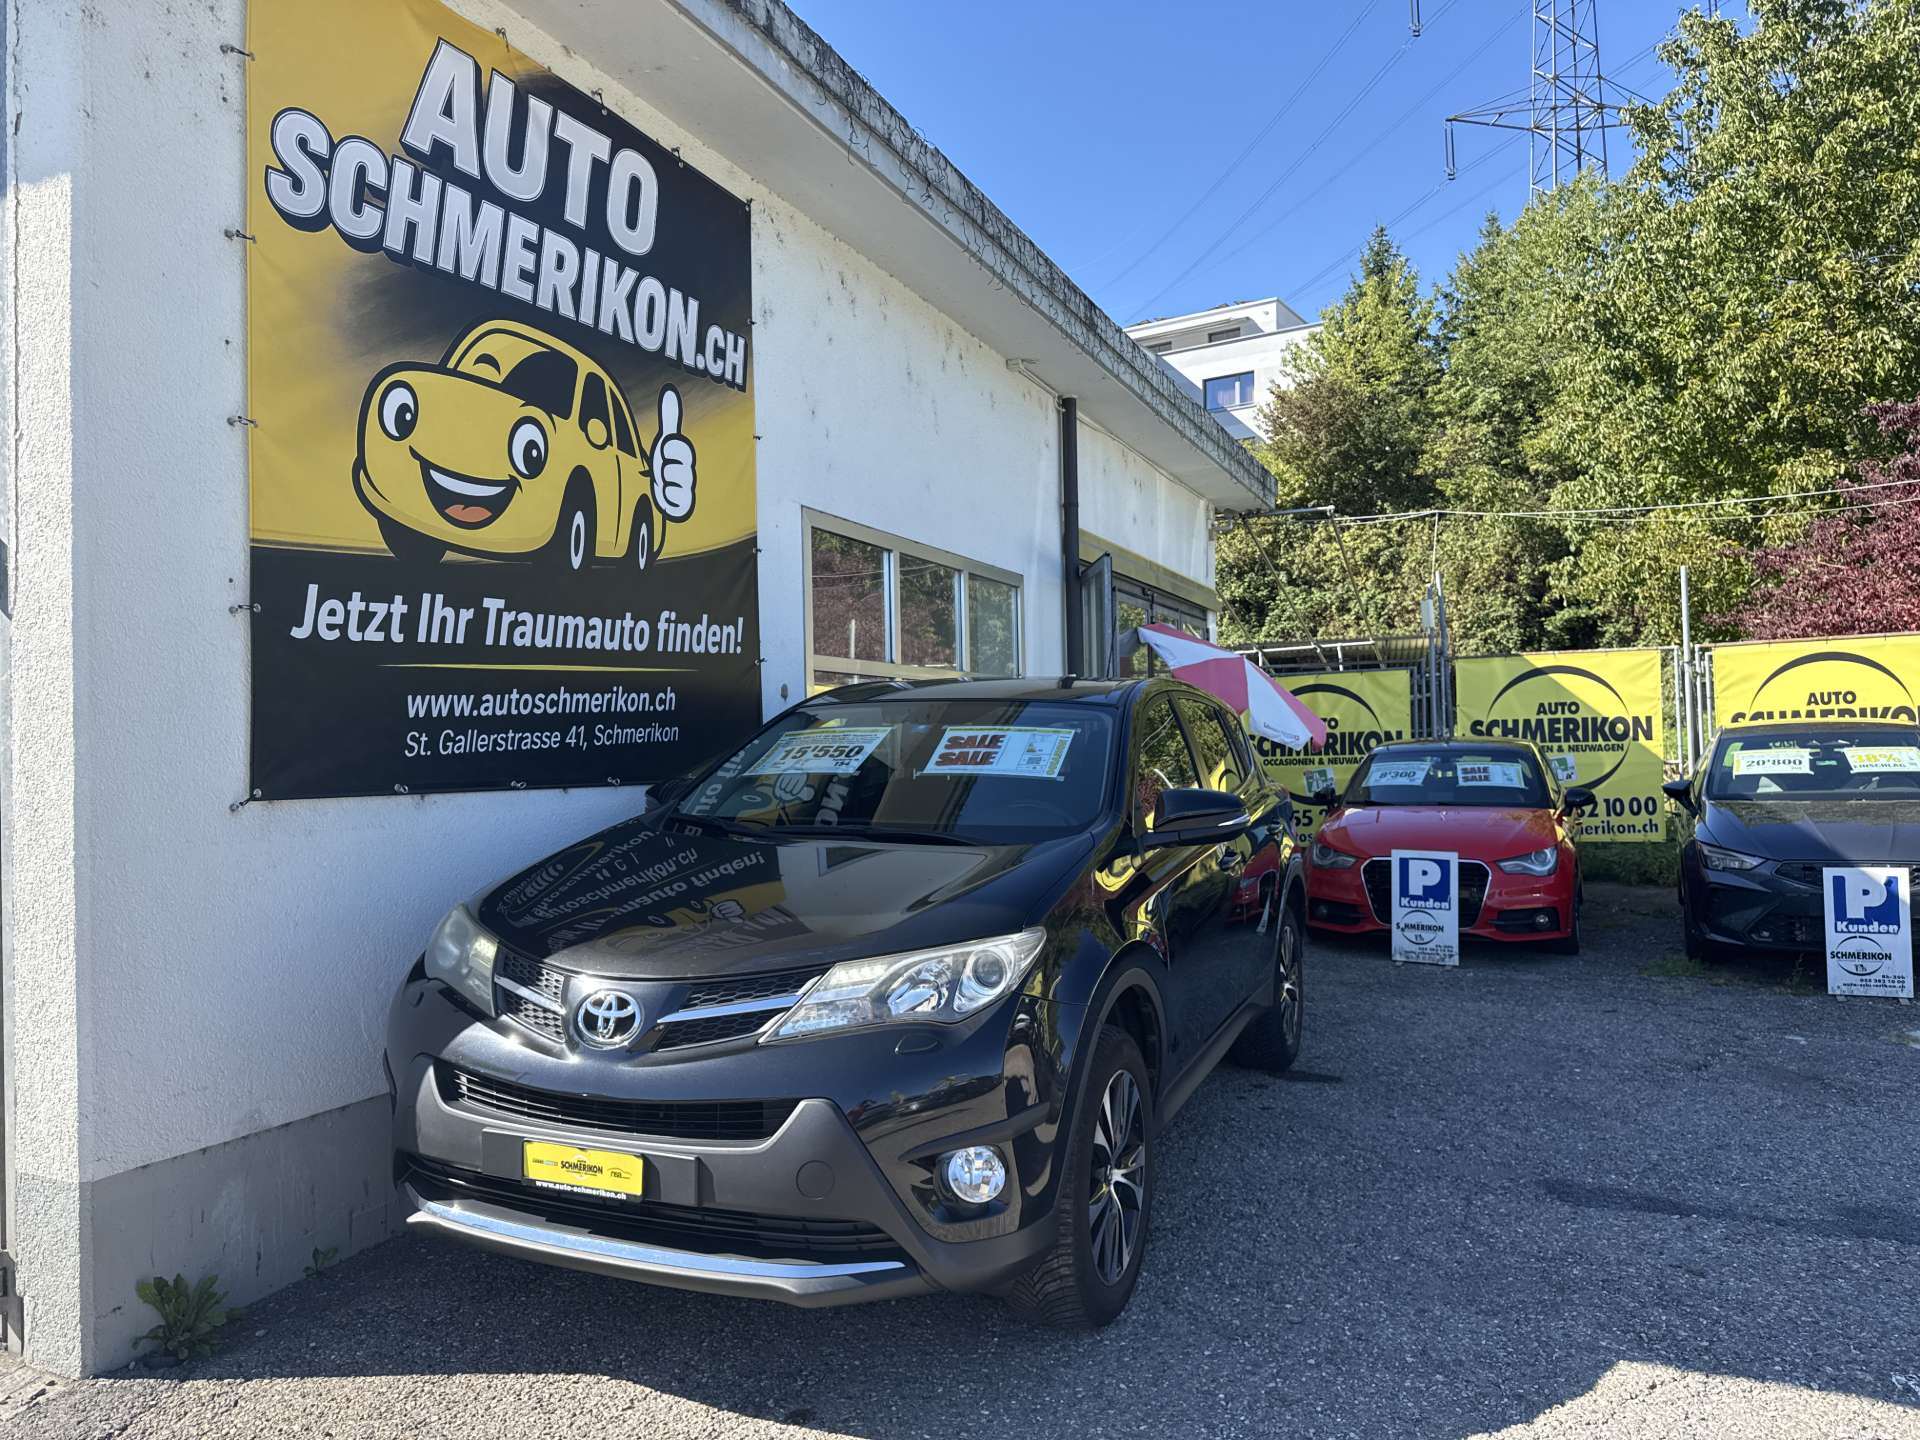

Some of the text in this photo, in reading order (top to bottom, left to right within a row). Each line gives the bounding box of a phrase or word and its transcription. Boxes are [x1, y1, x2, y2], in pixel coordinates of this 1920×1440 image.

[402, 37, 659, 255] AUTO
[264, 107, 748, 387] SCHMERIKON.CH
[290, 583, 744, 654] Jetzt Ihr Traumauto finden!
[407, 687, 676, 718] www.autoschmerikon.ch
[1806, 691, 1857, 706] AUTO
[1536, 702, 1580, 715] AUTO
[1470, 716, 1653, 742] SCHMERIKON
[405, 723, 679, 758] St. Gallerstrasse 41, Schmerikon
[944, 734, 1007, 750] SALE
[1568, 743, 1624, 752] NEUWAGEN
[781, 745, 864, 760] 15'550
[935, 751, 998, 766] SALE
[1263, 758, 1316, 766] OCCASIONEN
[1408, 859, 1441, 895] P
[1401, 897, 1450, 909] Kunden
[1845, 876, 1887, 918] P
[1837, 921, 1898, 933] Kunden
[1830, 951, 1892, 961] SCHMERIKON
[560, 1160, 603, 1175] SCHMERIKON
